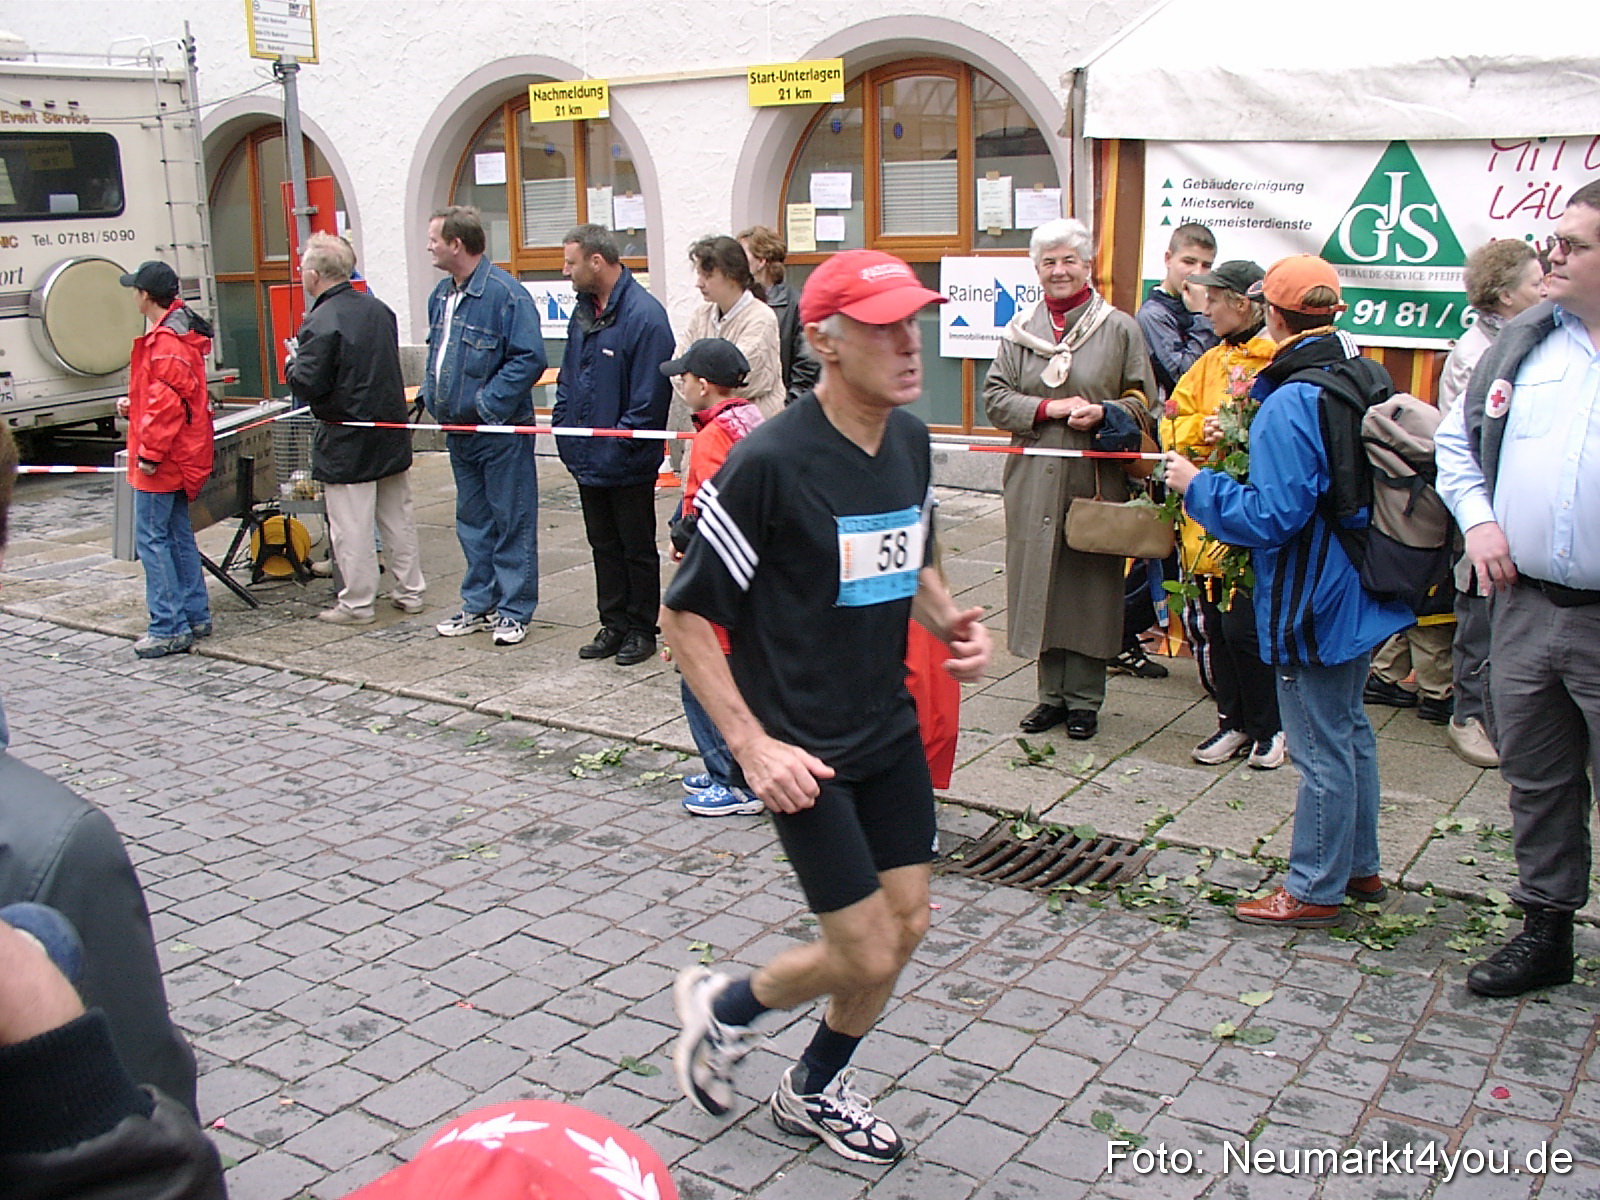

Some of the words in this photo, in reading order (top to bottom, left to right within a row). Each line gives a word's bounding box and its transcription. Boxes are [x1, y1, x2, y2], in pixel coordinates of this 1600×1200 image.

[750, 68, 841, 84] Start-Unterlagen
[533, 86, 604, 102] Nachmeldung
[778, 87, 791, 100] 21
[795, 86, 812, 99] km
[0, 111, 38, 124] Event
[43, 112, 91, 125] Service
[555, 105, 566, 117] 21
[568, 104, 583, 116] km
[1182, 177, 1305, 195] Gebäudereinigung
[1180, 197, 1255, 210] Mietservice
[1180, 215, 1312, 230] Hausmeisterdienste
[32, 234, 53, 246] Tel.
[949, 284, 1003, 302] Rainer
[877, 531, 907, 572] 58
